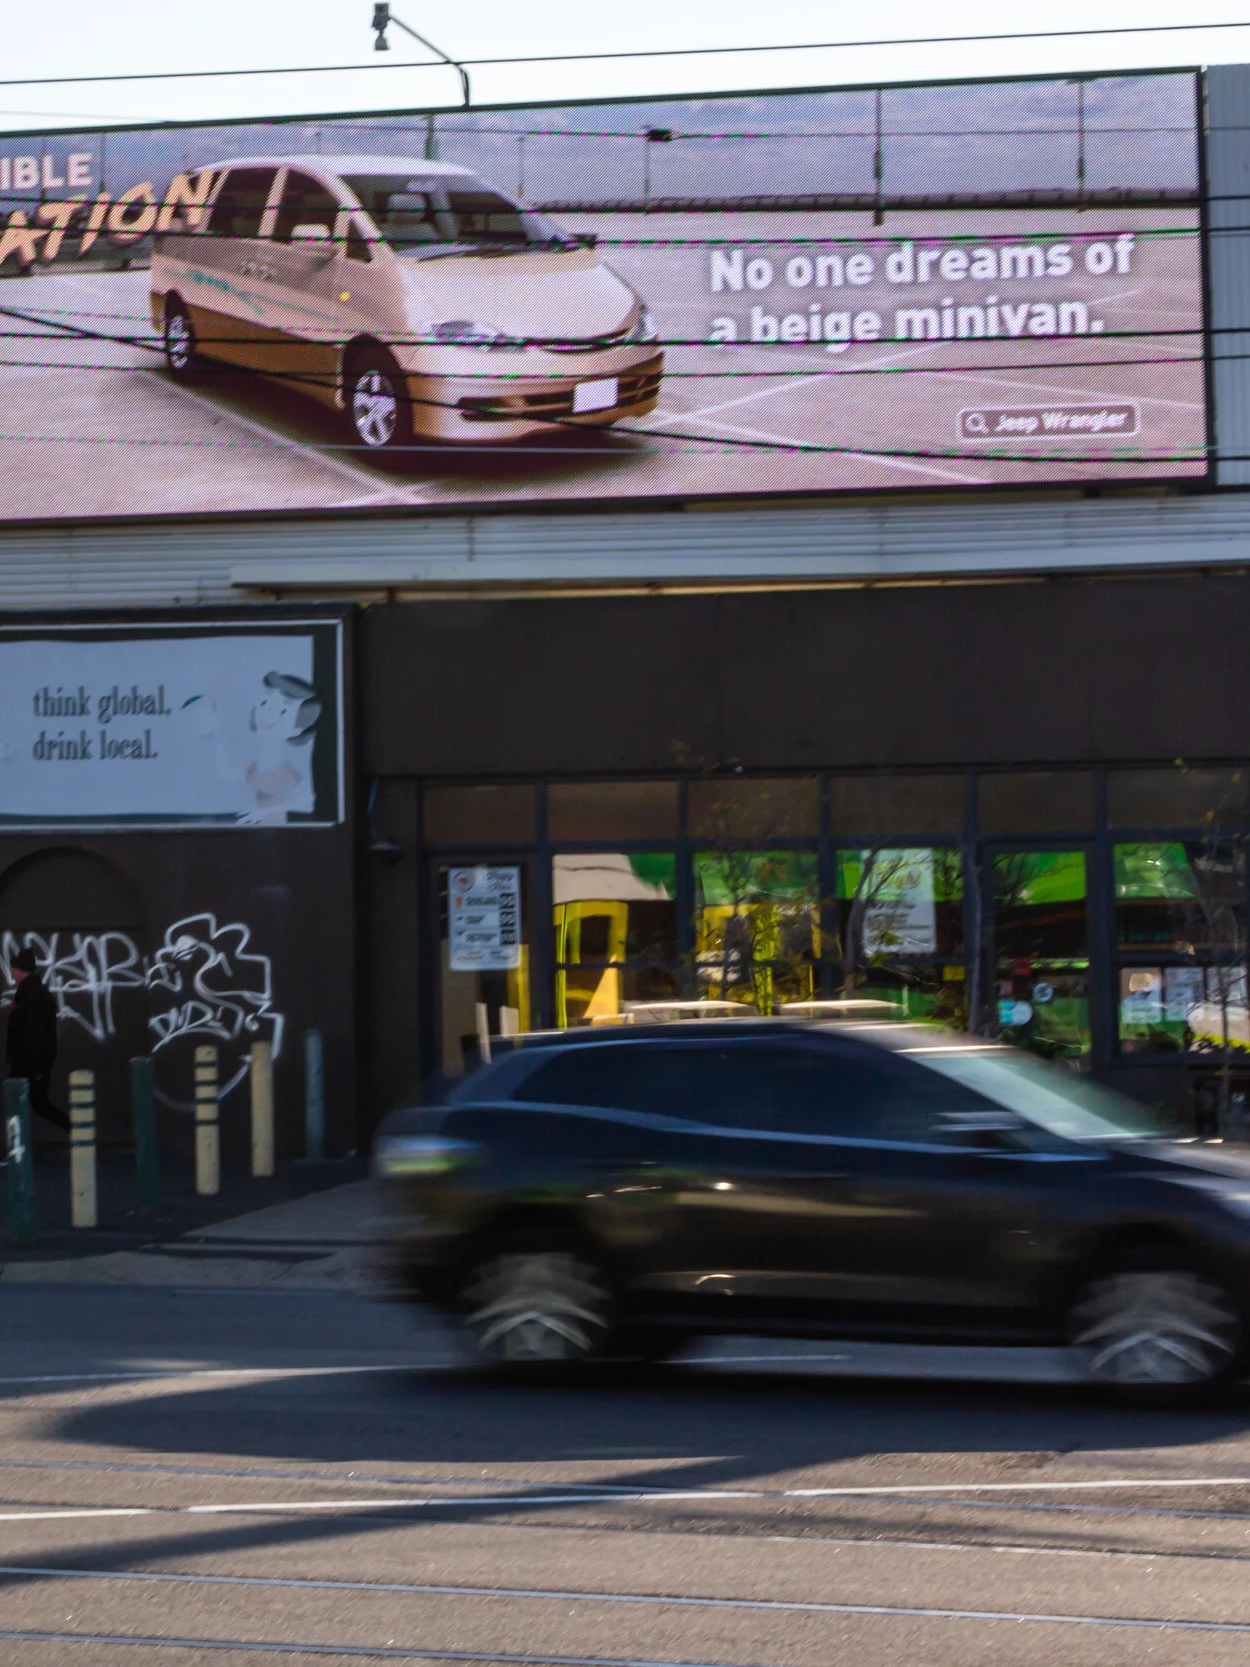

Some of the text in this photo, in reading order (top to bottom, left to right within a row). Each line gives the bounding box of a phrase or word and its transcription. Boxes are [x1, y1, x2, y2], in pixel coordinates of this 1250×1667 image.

[709, 233, 1136, 293] No one dreams of
[709, 296, 1105, 354] a beige minivan.
[1041, 409, 1129, 433] Wrangler
[32, 685, 92, 717] think
[32, 728, 159, 760] drink local.
